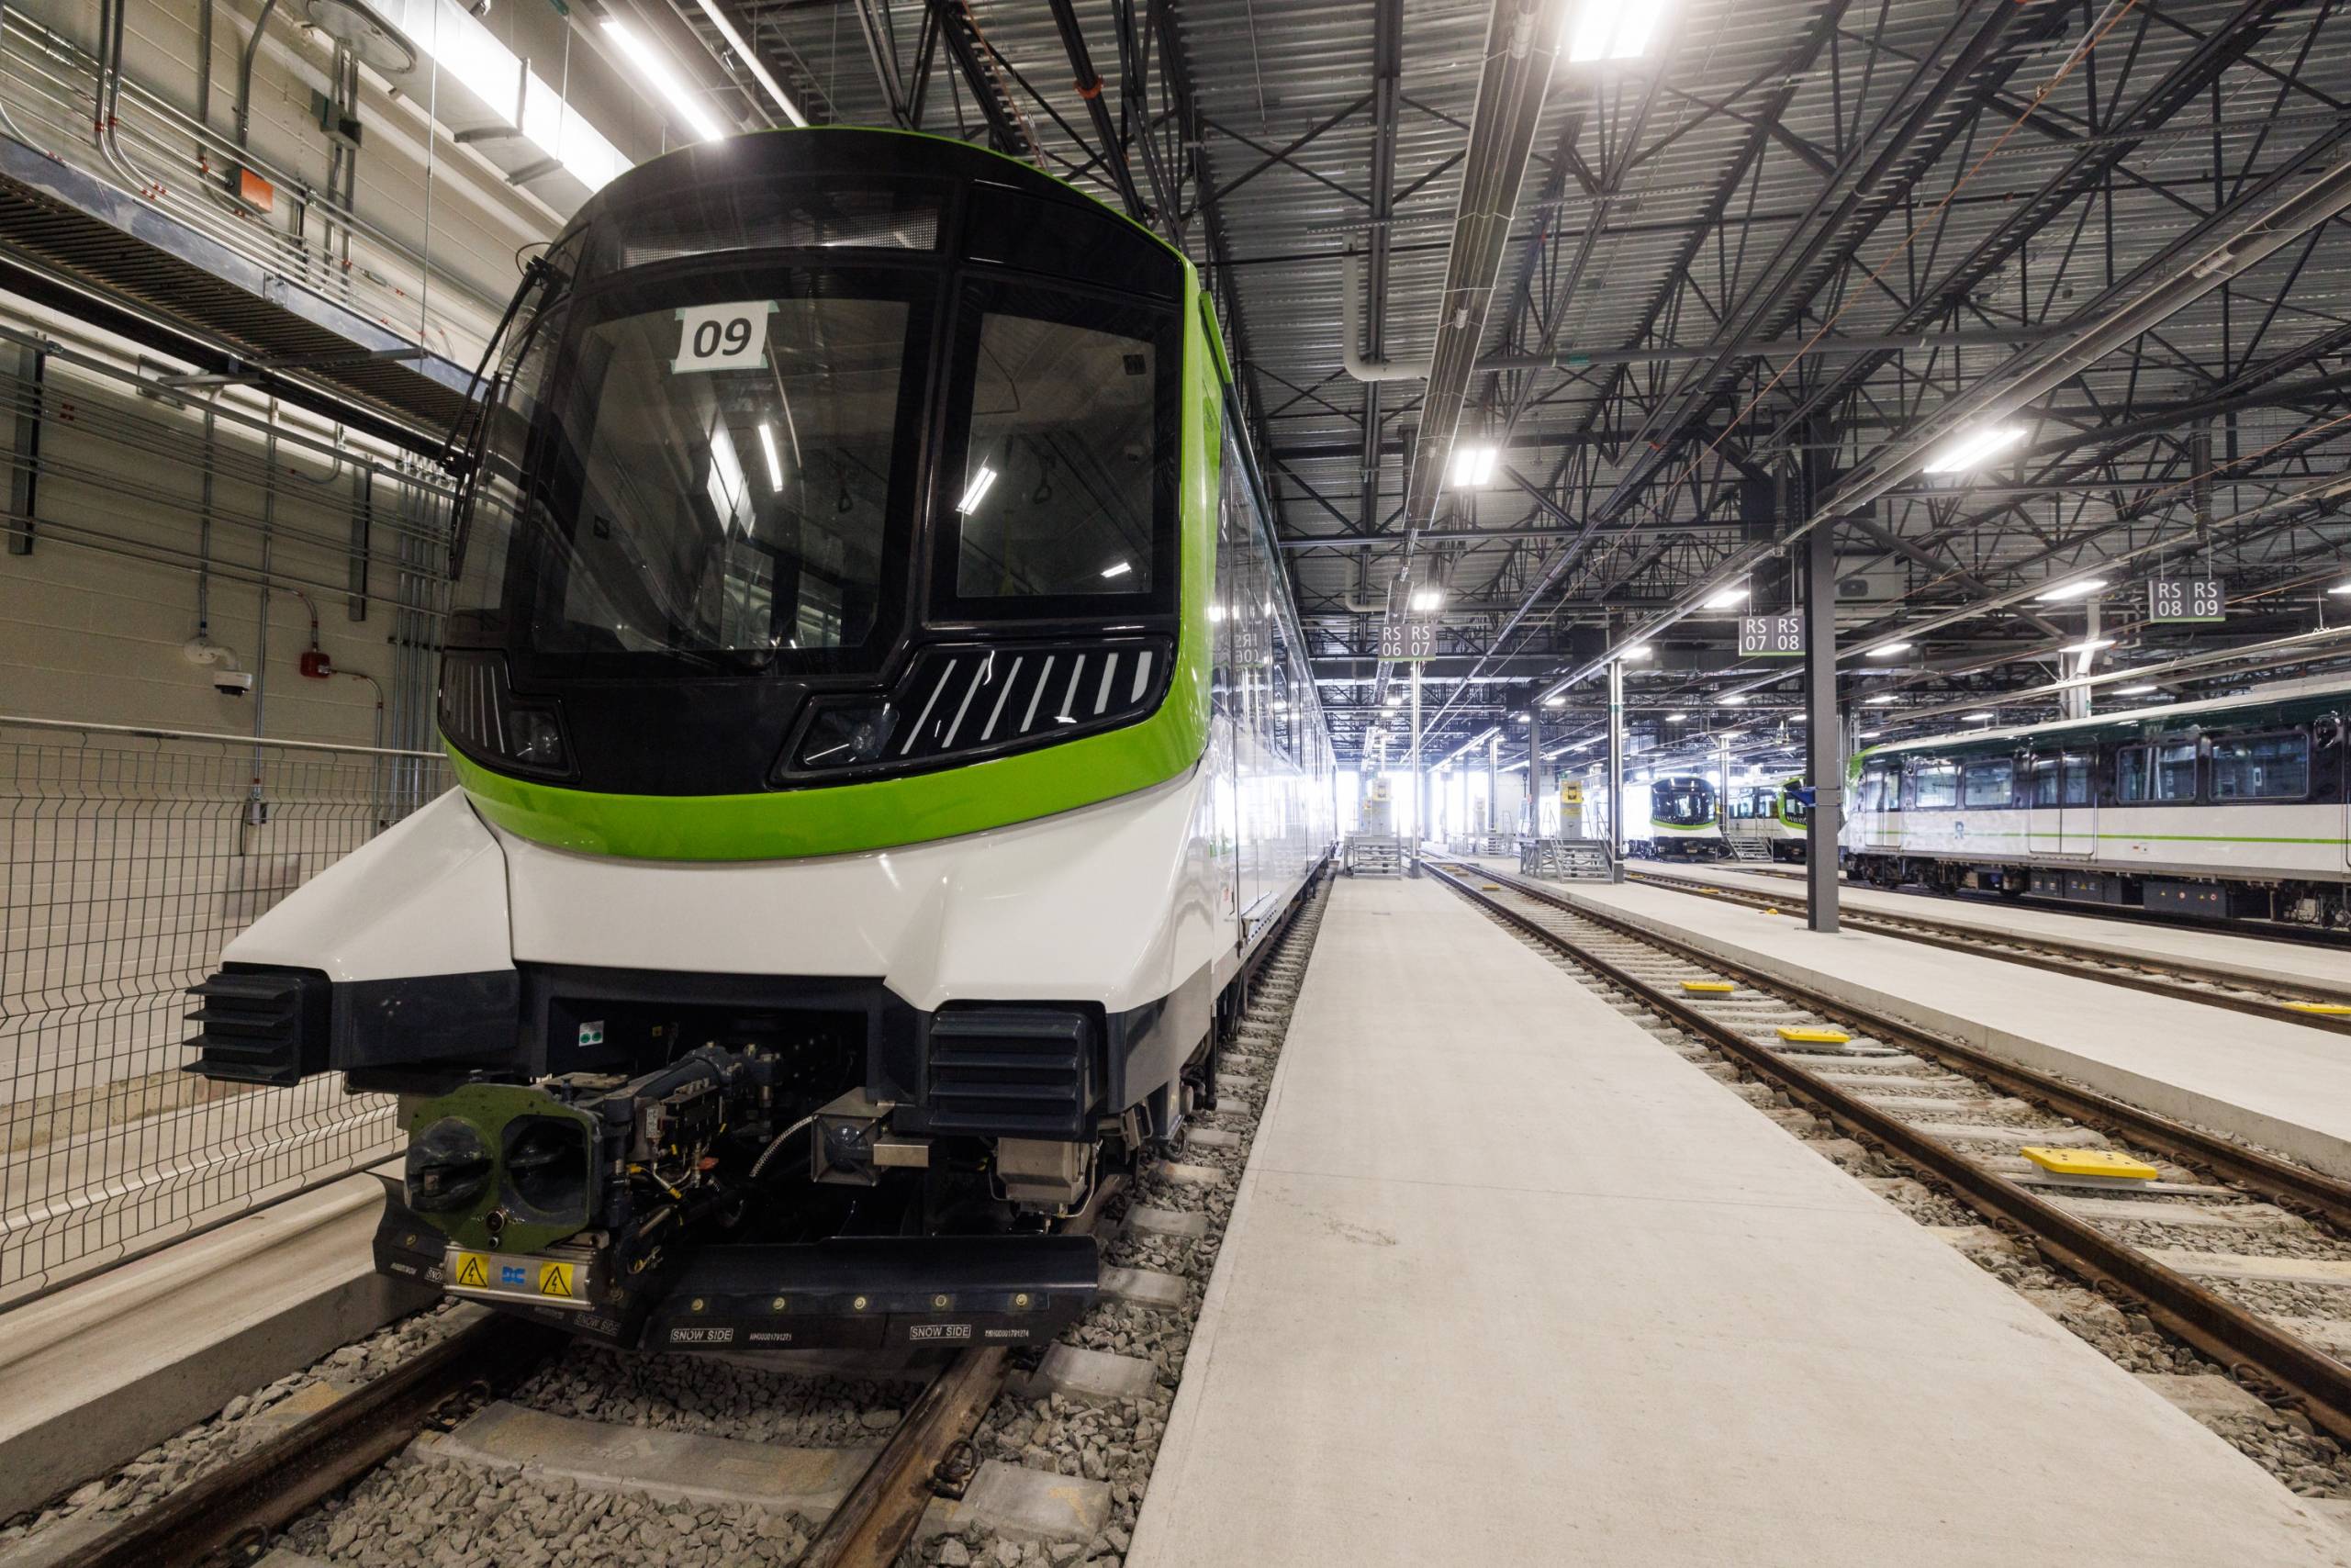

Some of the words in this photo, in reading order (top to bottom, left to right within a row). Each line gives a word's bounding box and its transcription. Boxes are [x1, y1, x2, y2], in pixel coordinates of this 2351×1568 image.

[693, 317, 752, 358] 09
[2158, 582, 2181, 599] RS
[2194, 581, 2218, 598] RS
[2158, 600, 2182, 617] 08
[2194, 599, 2218, 616] 09
[1411, 625, 1430, 640] RS
[1746, 618, 1767, 633] RS
[1778, 618, 1799, 633] RS
[1383, 626, 1402, 641] RS
[1383, 642, 1402, 656] 06
[1411, 642, 1430, 655] 07
[1745, 635, 1767, 651] 07
[1777, 634, 1799, 651] 08
[673, 1330, 703, 1340] SNOW
[707, 1330, 732, 1340] SIDE
[912, 1327, 942, 1338] SNOW
[946, 1327, 968, 1337] SIDE
